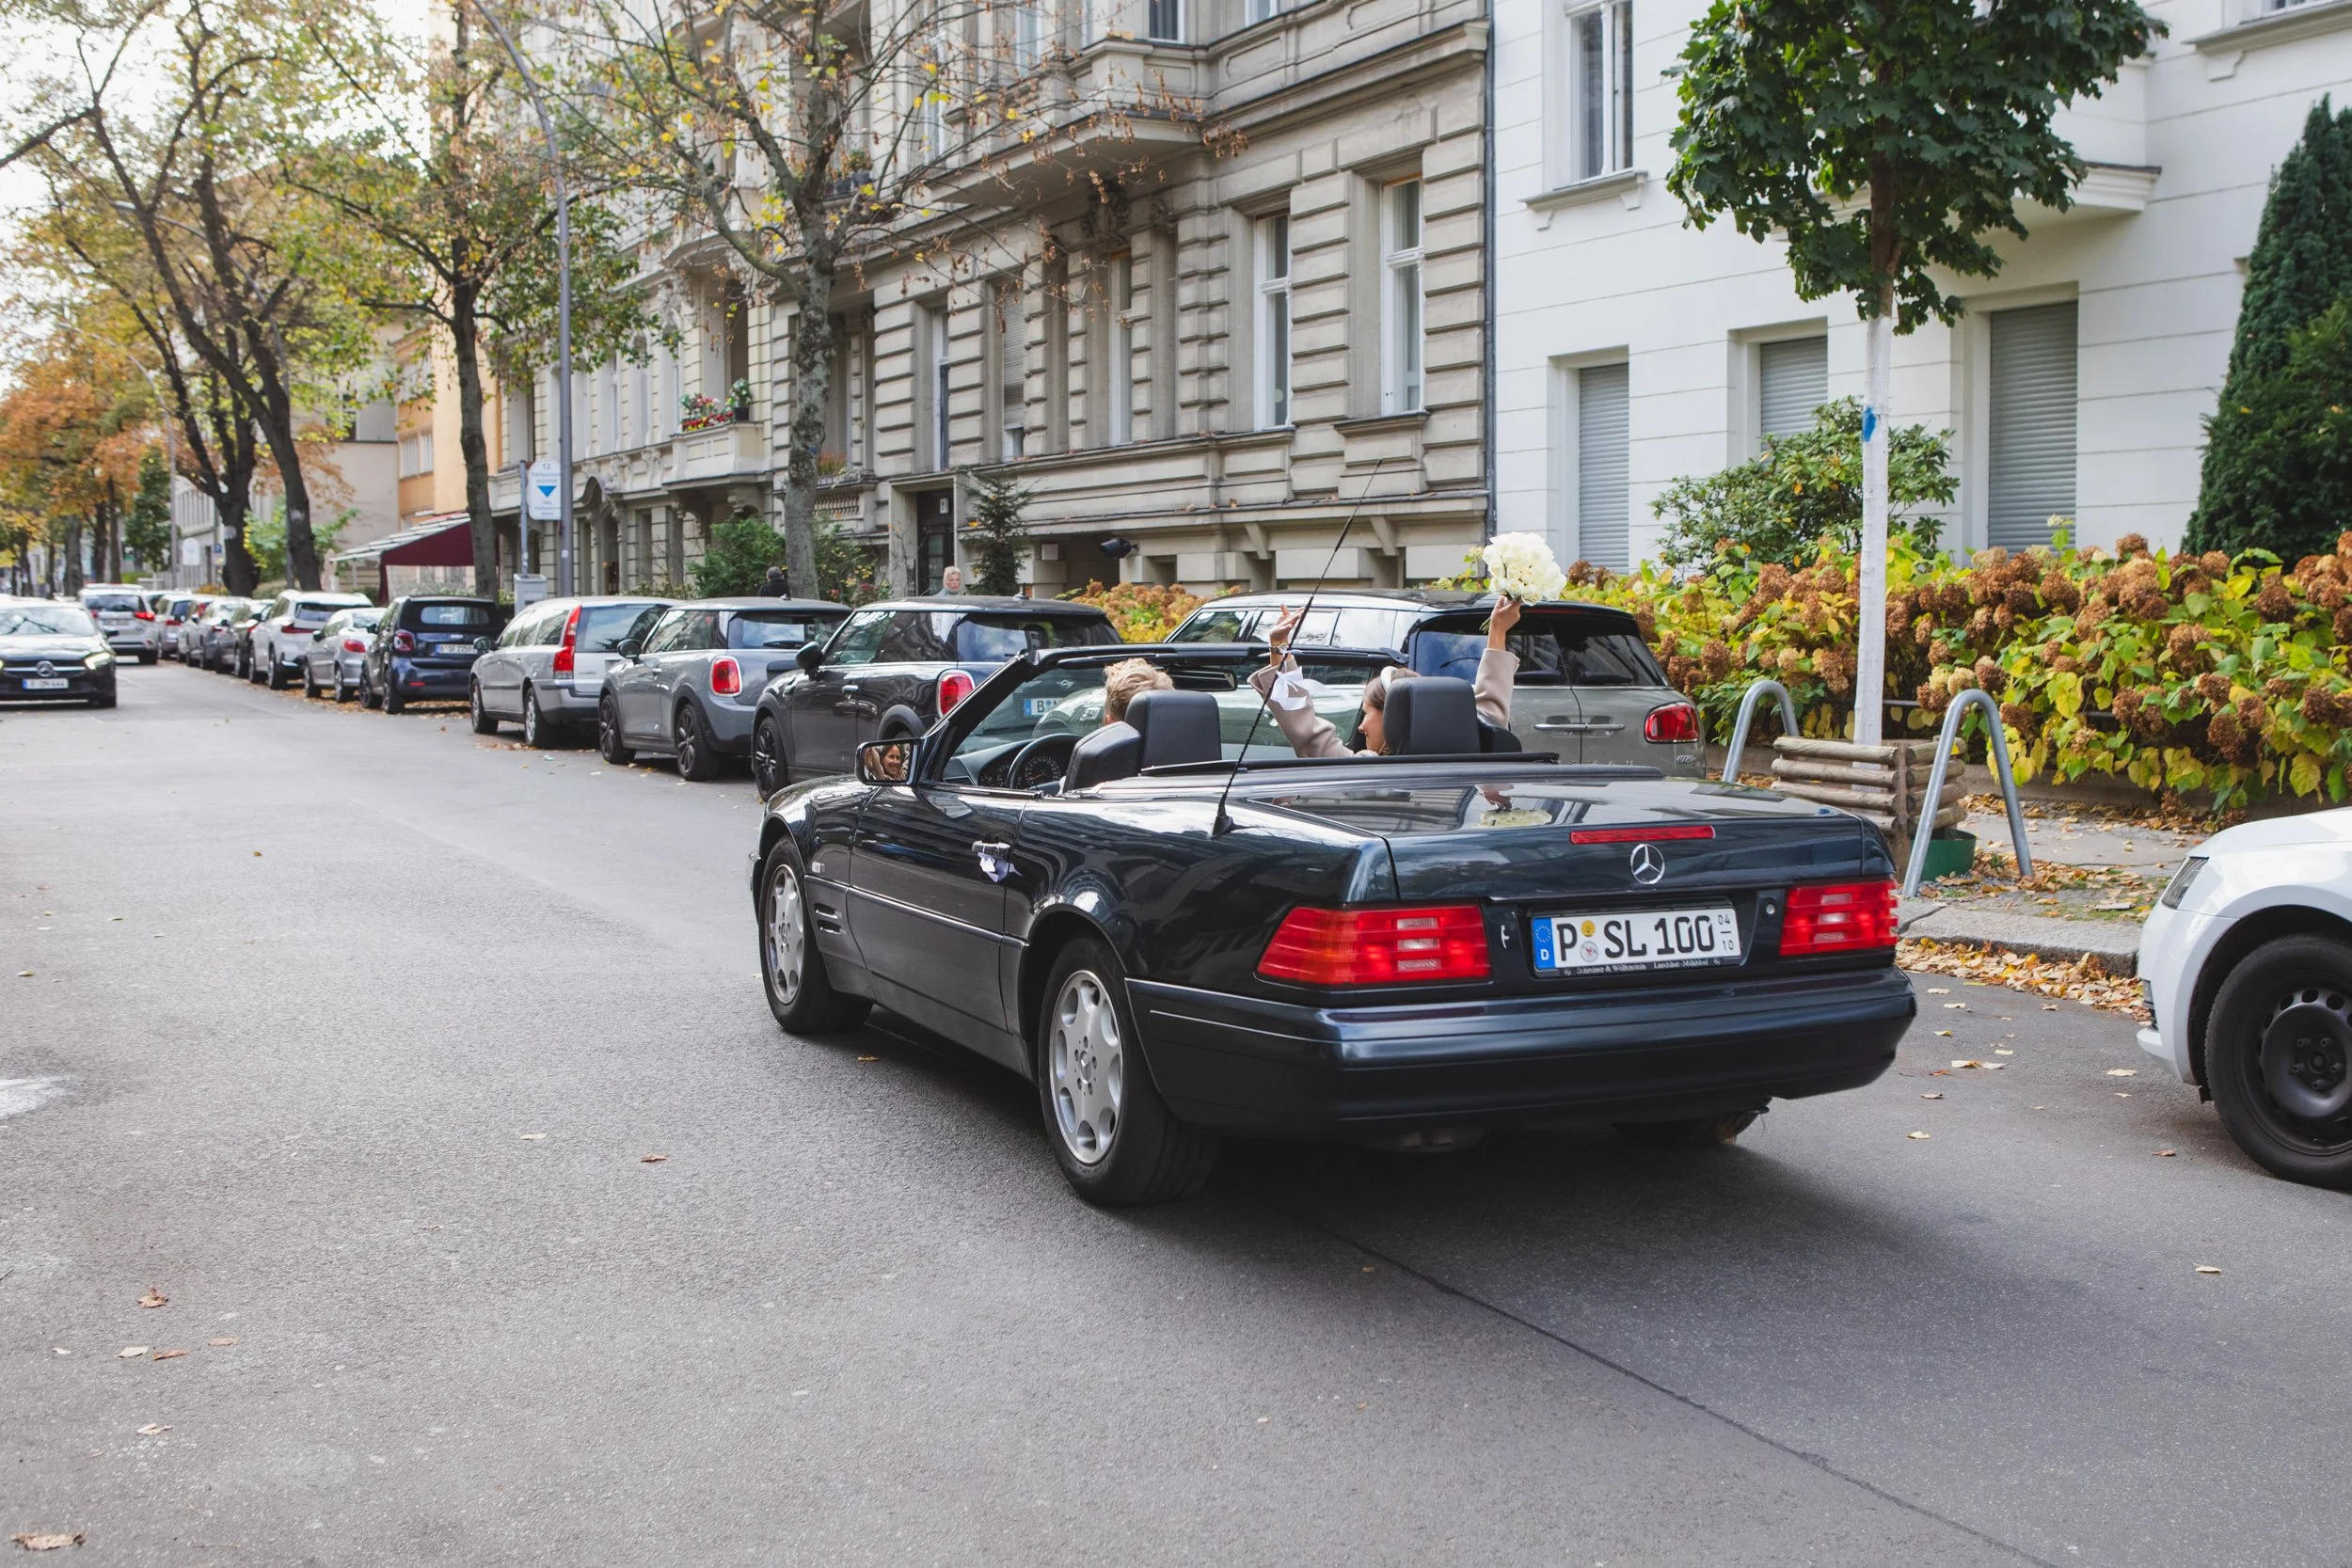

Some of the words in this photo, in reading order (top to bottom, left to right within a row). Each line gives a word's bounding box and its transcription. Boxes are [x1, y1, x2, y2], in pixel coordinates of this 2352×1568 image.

[1037, 700, 1045, 713] B
[1718, 914, 1730, 925] 04
[1556, 924, 1578, 961] P
[1604, 919, 1647, 958] SL
[1654, 915, 1714, 955] 100
[1723, 940, 1734, 951] 10
[1540, 949, 1549, 960] D
